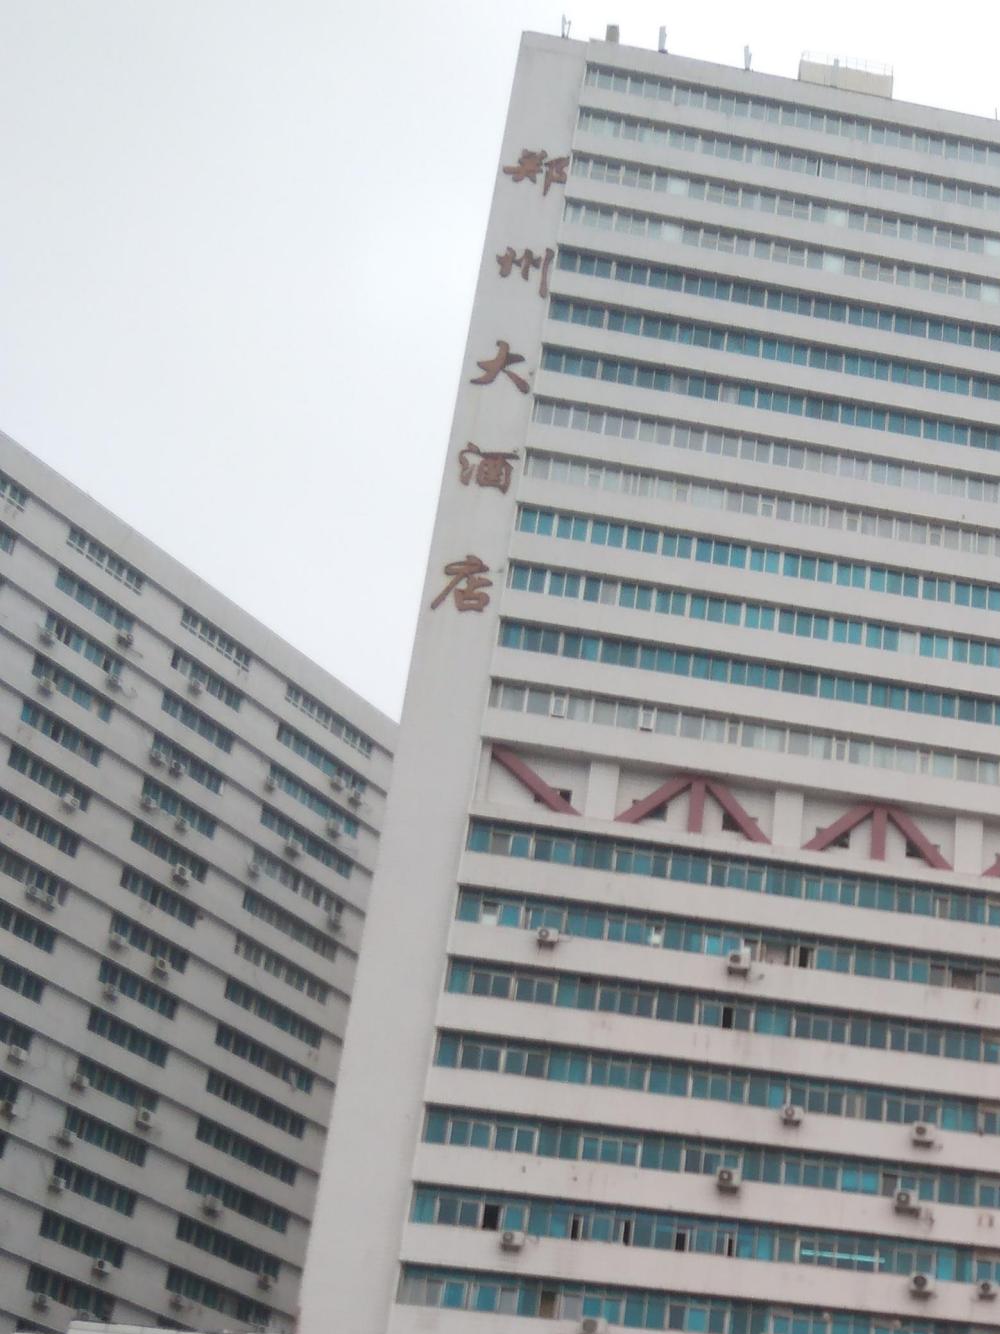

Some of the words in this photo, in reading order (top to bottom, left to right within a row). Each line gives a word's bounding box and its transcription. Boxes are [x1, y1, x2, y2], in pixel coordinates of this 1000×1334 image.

[431, 148, 572, 614] 郑州大酒店
